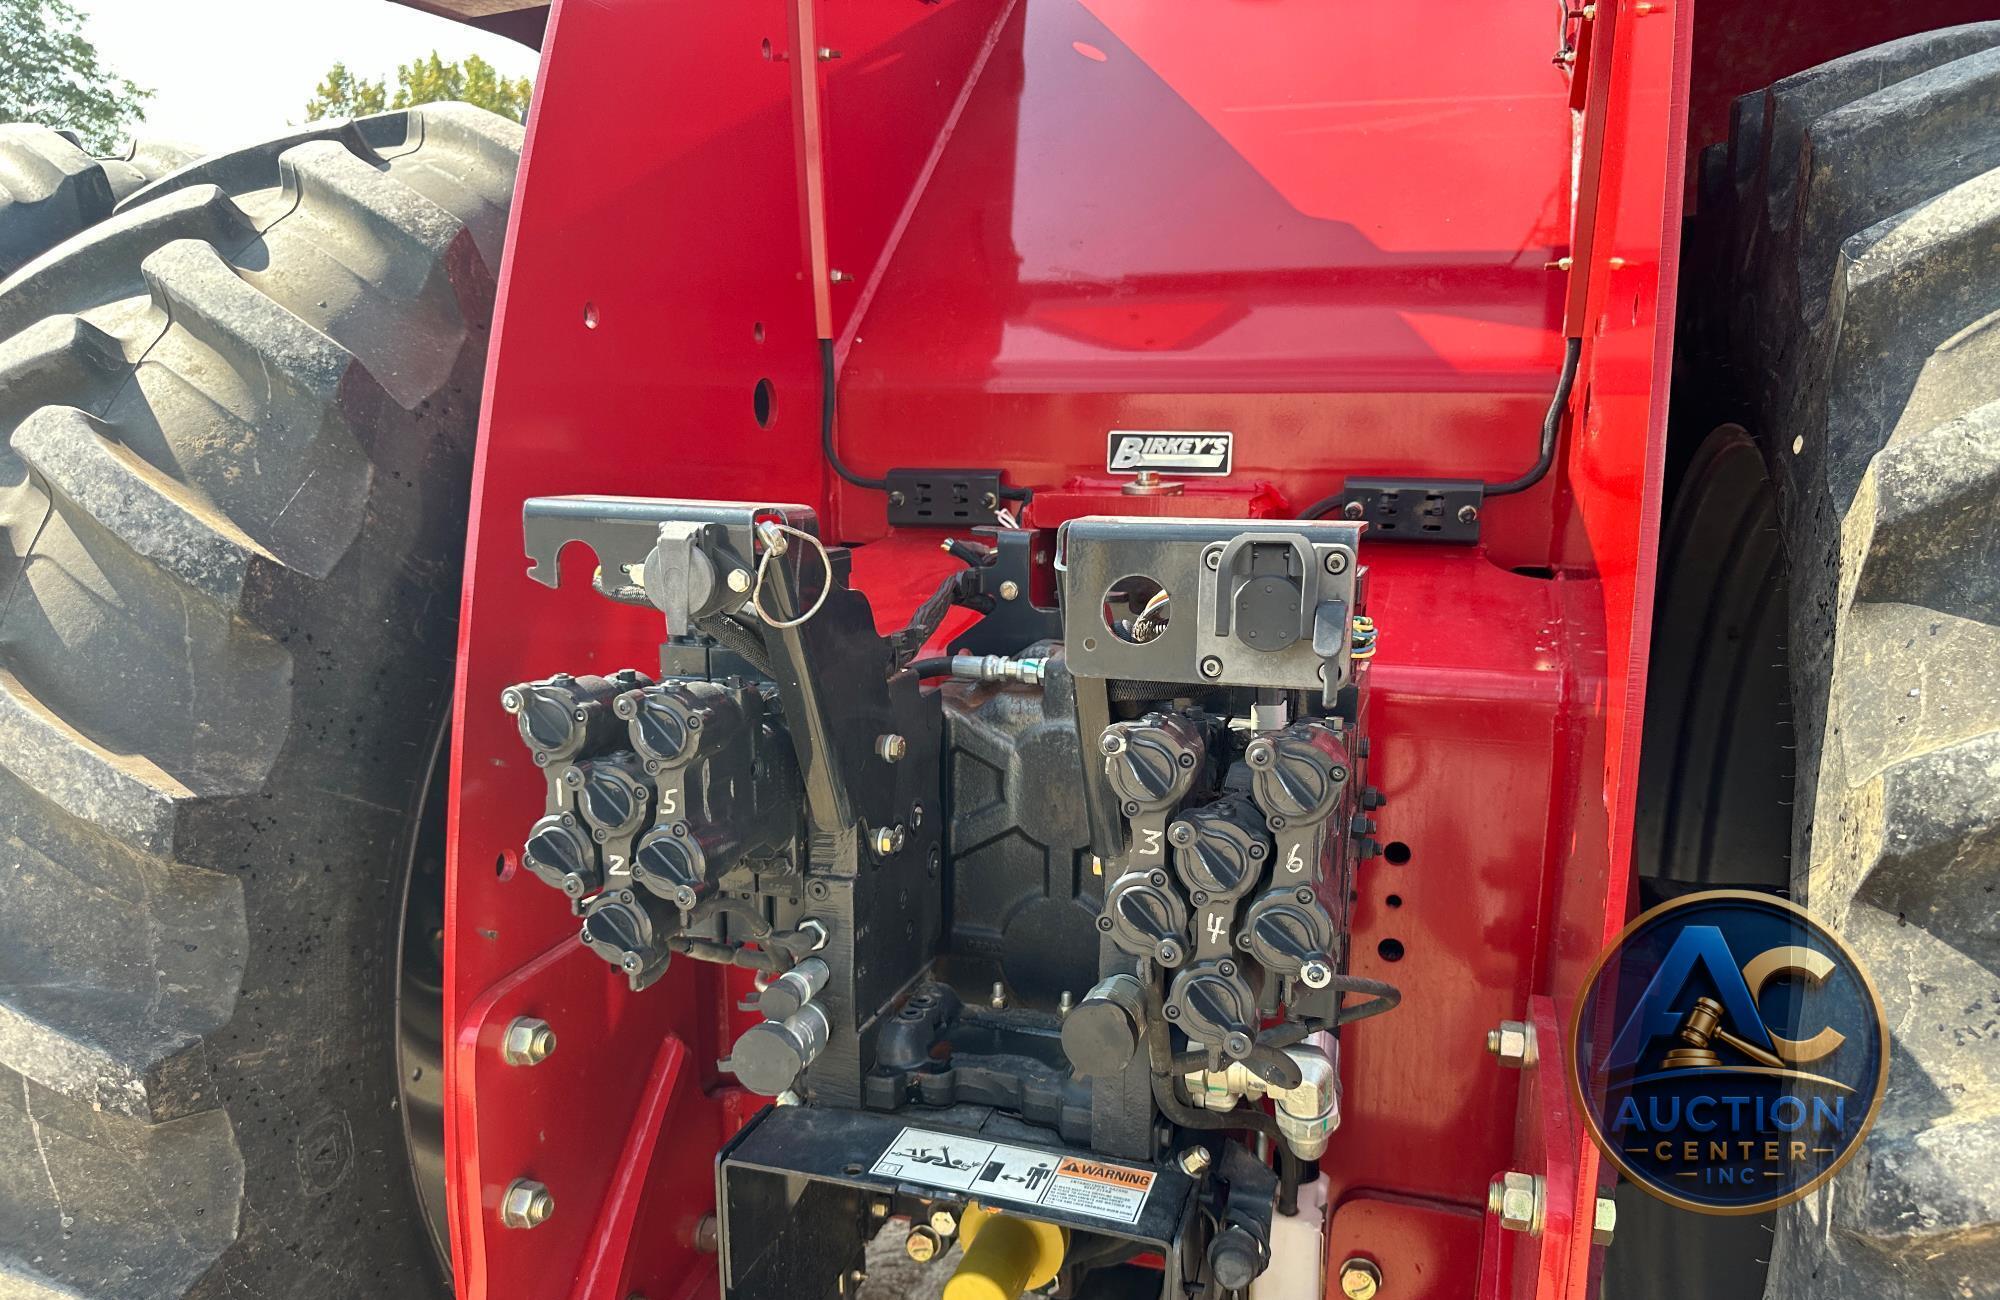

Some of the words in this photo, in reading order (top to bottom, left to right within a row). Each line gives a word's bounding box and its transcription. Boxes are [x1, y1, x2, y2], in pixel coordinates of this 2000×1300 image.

[1111, 436, 1229, 469] BIRKEY'S
[660, 788, 678, 815] 5
[1139, 829, 1163, 855] 3
[608, 855, 630, 876] 2
[1286, 843, 1304, 873] 6
[1206, 912, 1227, 943] 4
[1081, 1164, 1150, 1186] WARNING
